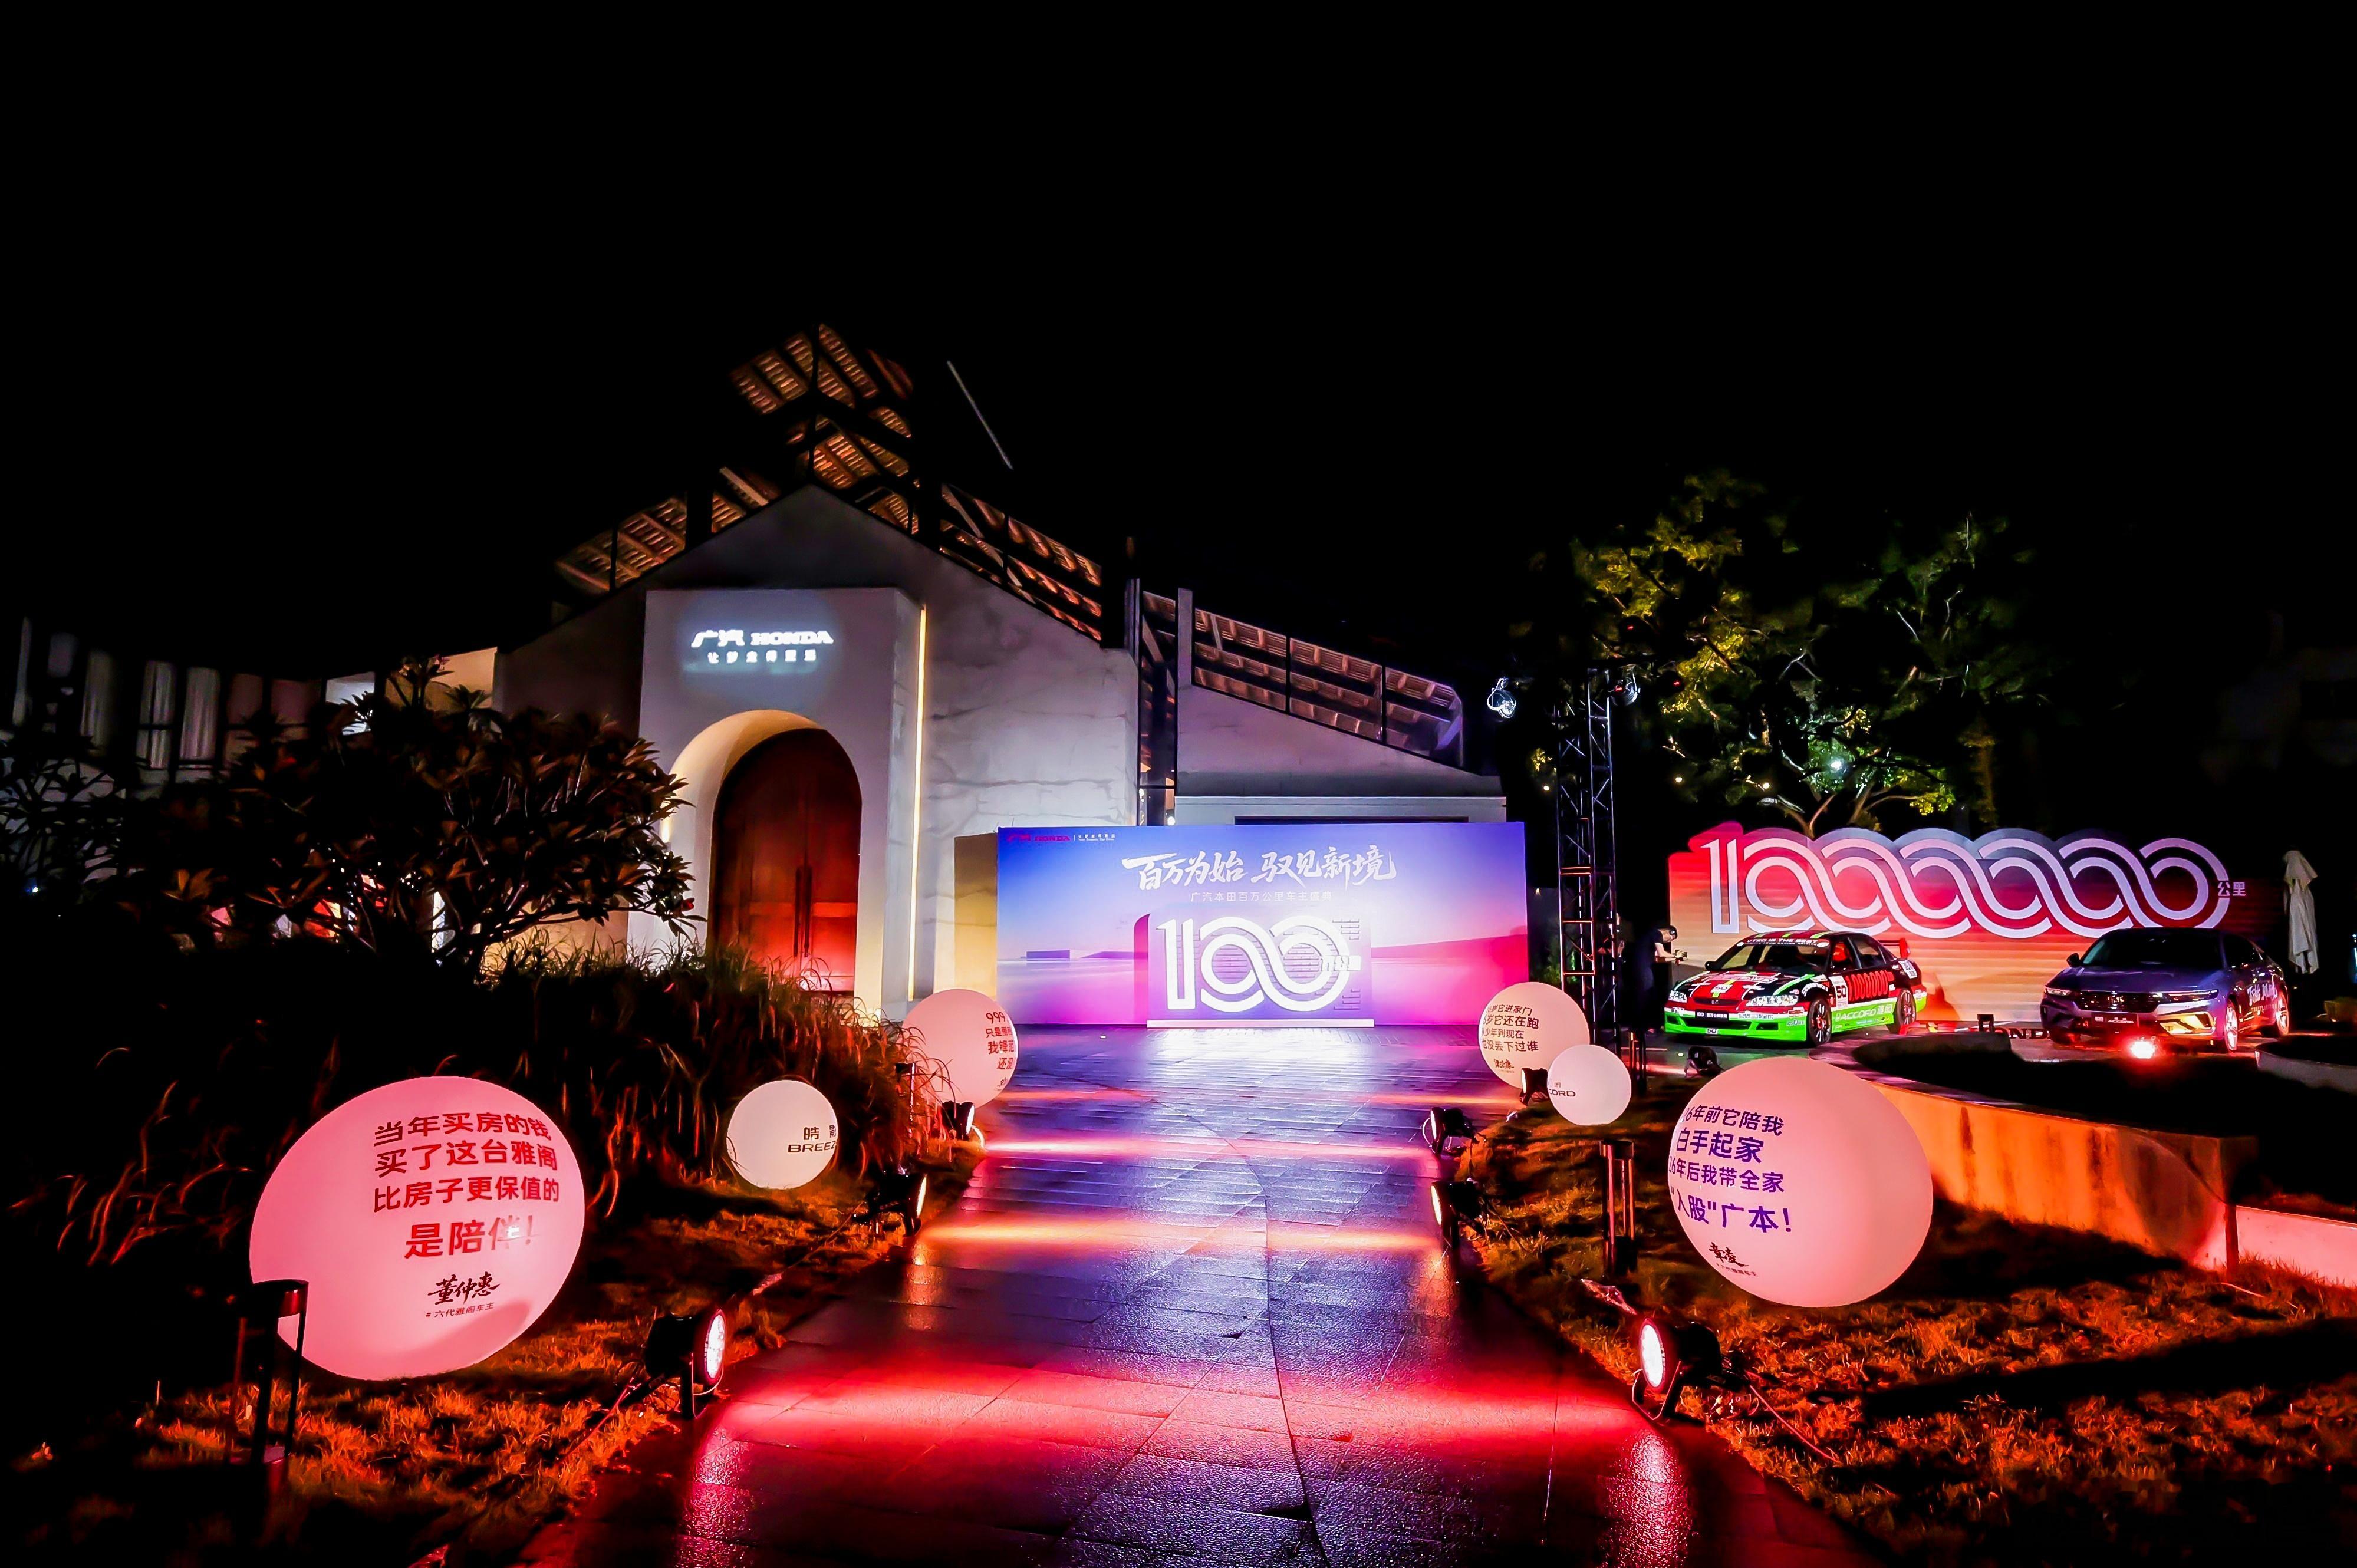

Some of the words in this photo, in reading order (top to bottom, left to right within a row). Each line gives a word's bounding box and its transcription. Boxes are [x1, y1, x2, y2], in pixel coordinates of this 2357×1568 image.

[750, 631, 834, 646] HONDA
[1122, 850, 1248, 891] 百万为始
[1251, 844, 1397, 889] 驭见新境
[1190, 891, 1333, 902] 广汽本田百万公里车主盛典
[2217, 881, 2246, 897] 公里
[1836, 985, 1847, 999] 50
[1482, 1039, 1539, 1052] 也没丢下过谁
[373, 1112, 552, 1147] 当年买房的钱
[1676, 1127, 1764, 1164] 白手起家
[374, 1138, 558, 1178] 买了这台雅阁
[1668, 1155, 1785, 1193] 26年后我带全家
[374, 1175, 559, 1213] 比房子更保值的
[404, 1215, 533, 1259] 是陪伴!
